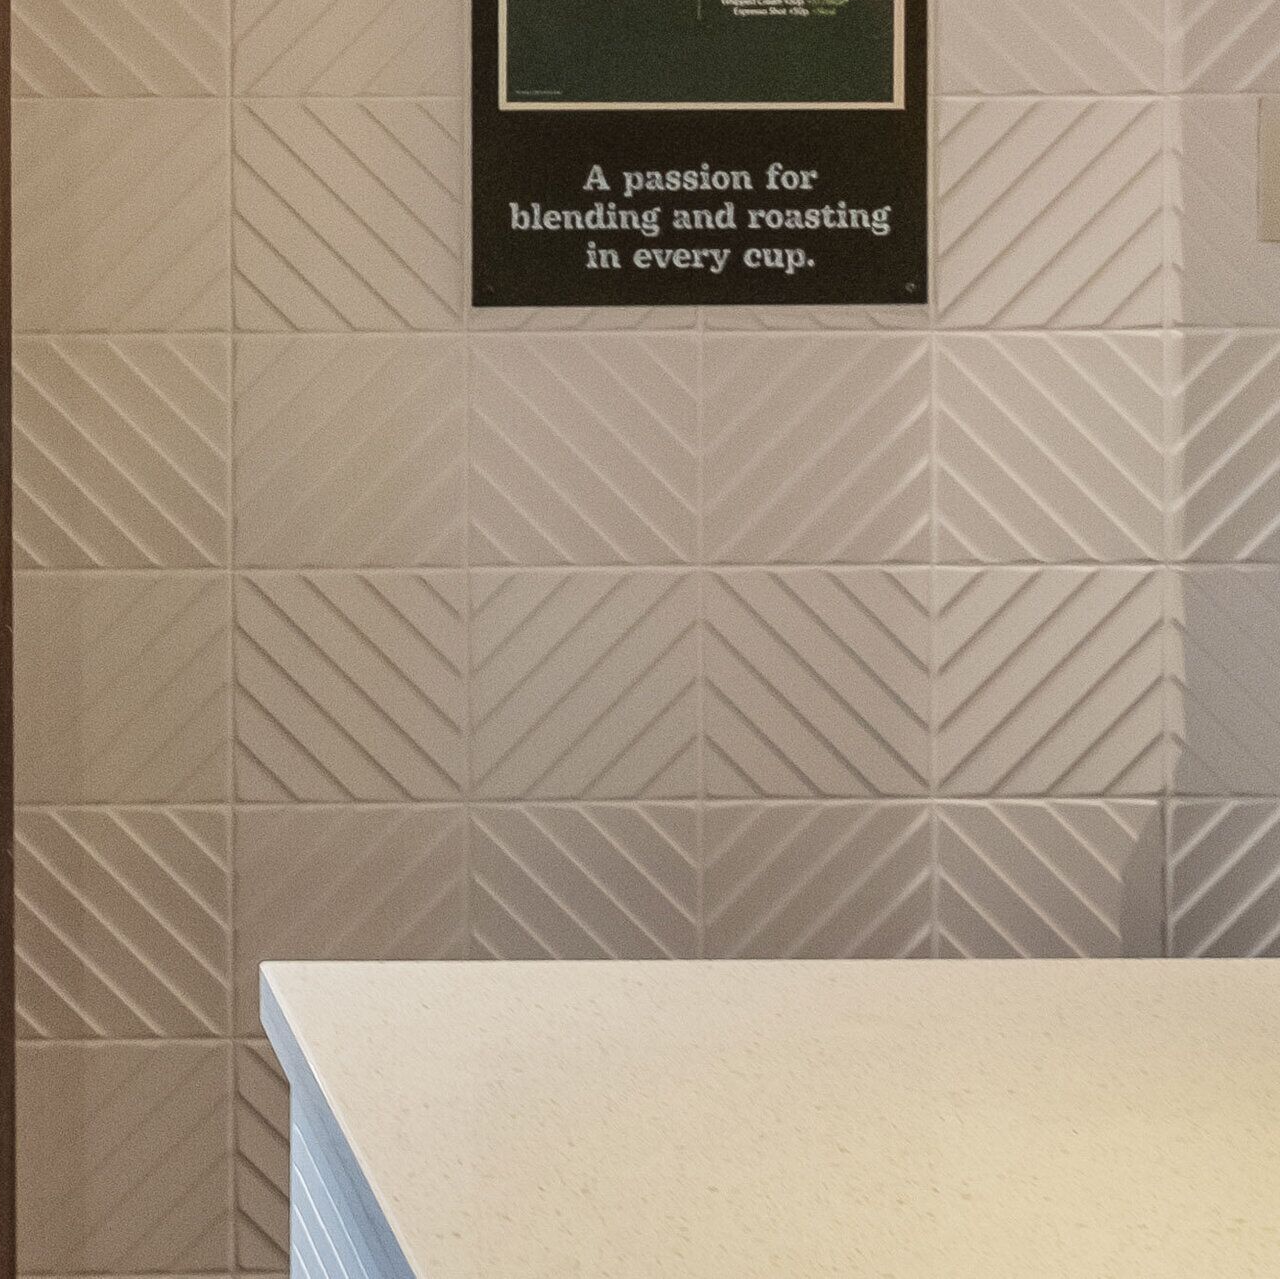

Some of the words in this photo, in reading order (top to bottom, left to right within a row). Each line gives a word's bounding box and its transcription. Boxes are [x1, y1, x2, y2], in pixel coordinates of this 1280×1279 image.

[583, 164, 611, 191] A
[622, 162, 753, 197] passion
[765, 162, 819, 191] for
[508, 201, 662, 237] blending
[671, 201, 737, 231] and
[747, 200, 892, 236] roasting
[585, 241, 622, 270] in
[632, 247, 732, 274] every
[743, 247, 815, 275] cup.
